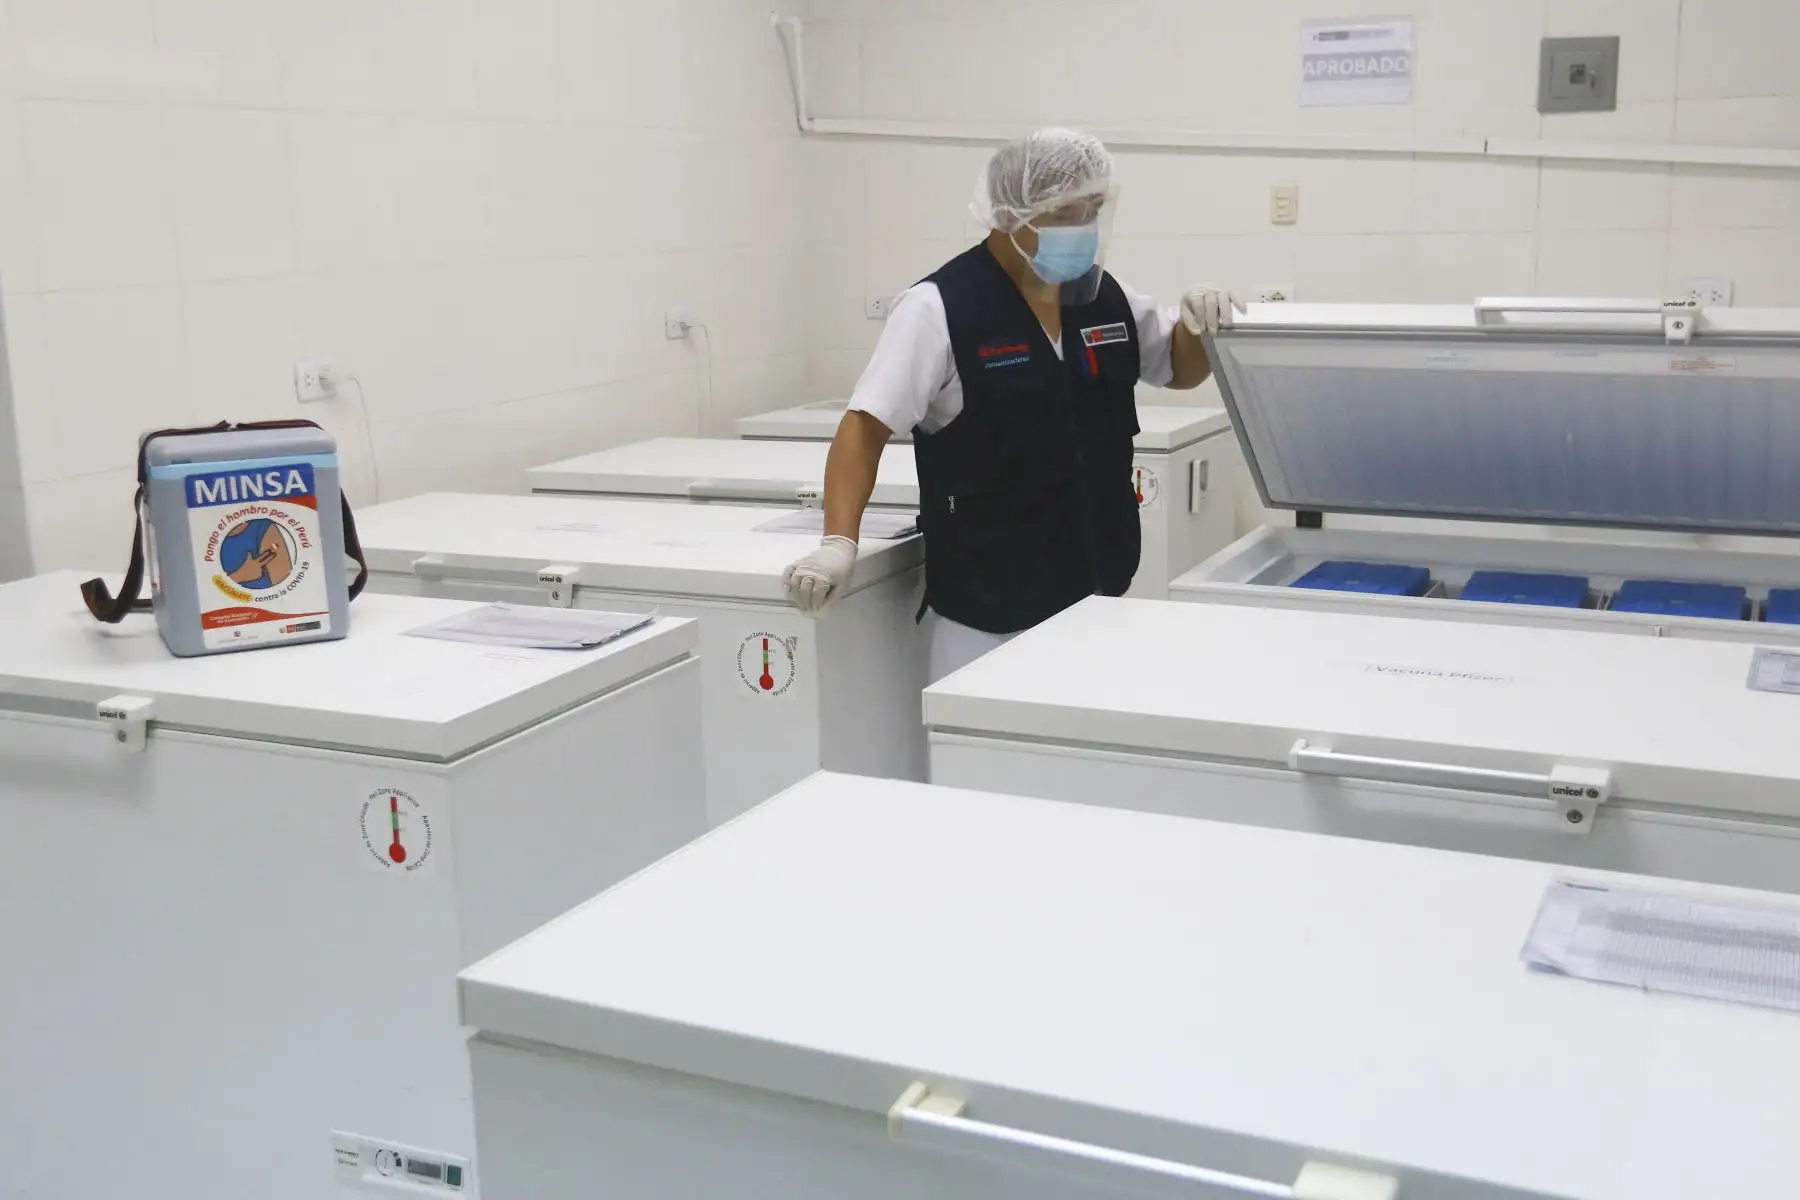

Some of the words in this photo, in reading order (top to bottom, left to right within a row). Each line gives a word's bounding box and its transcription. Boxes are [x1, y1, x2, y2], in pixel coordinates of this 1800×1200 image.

[1304, 56, 1409, 76] APROBADO
[1663, 300, 1685, 308] unicef
[195, 468, 308, 505] MINSA
[204, 530, 220, 562] Pongo
[217, 519, 227, 531] el
[226, 505, 268, 522] hombro
[269, 508, 290, 518] por
[288, 518, 301, 527] el
[254, 593, 279, 603] contra
[279, 589, 288, 598] la
[286, 561, 309, 591] COVID-19
[1377, 664, 1443, 677] Vacuna
[1449, 671, 1505, 681] Pfizer
[1552, 786, 1584, 797] unicef
